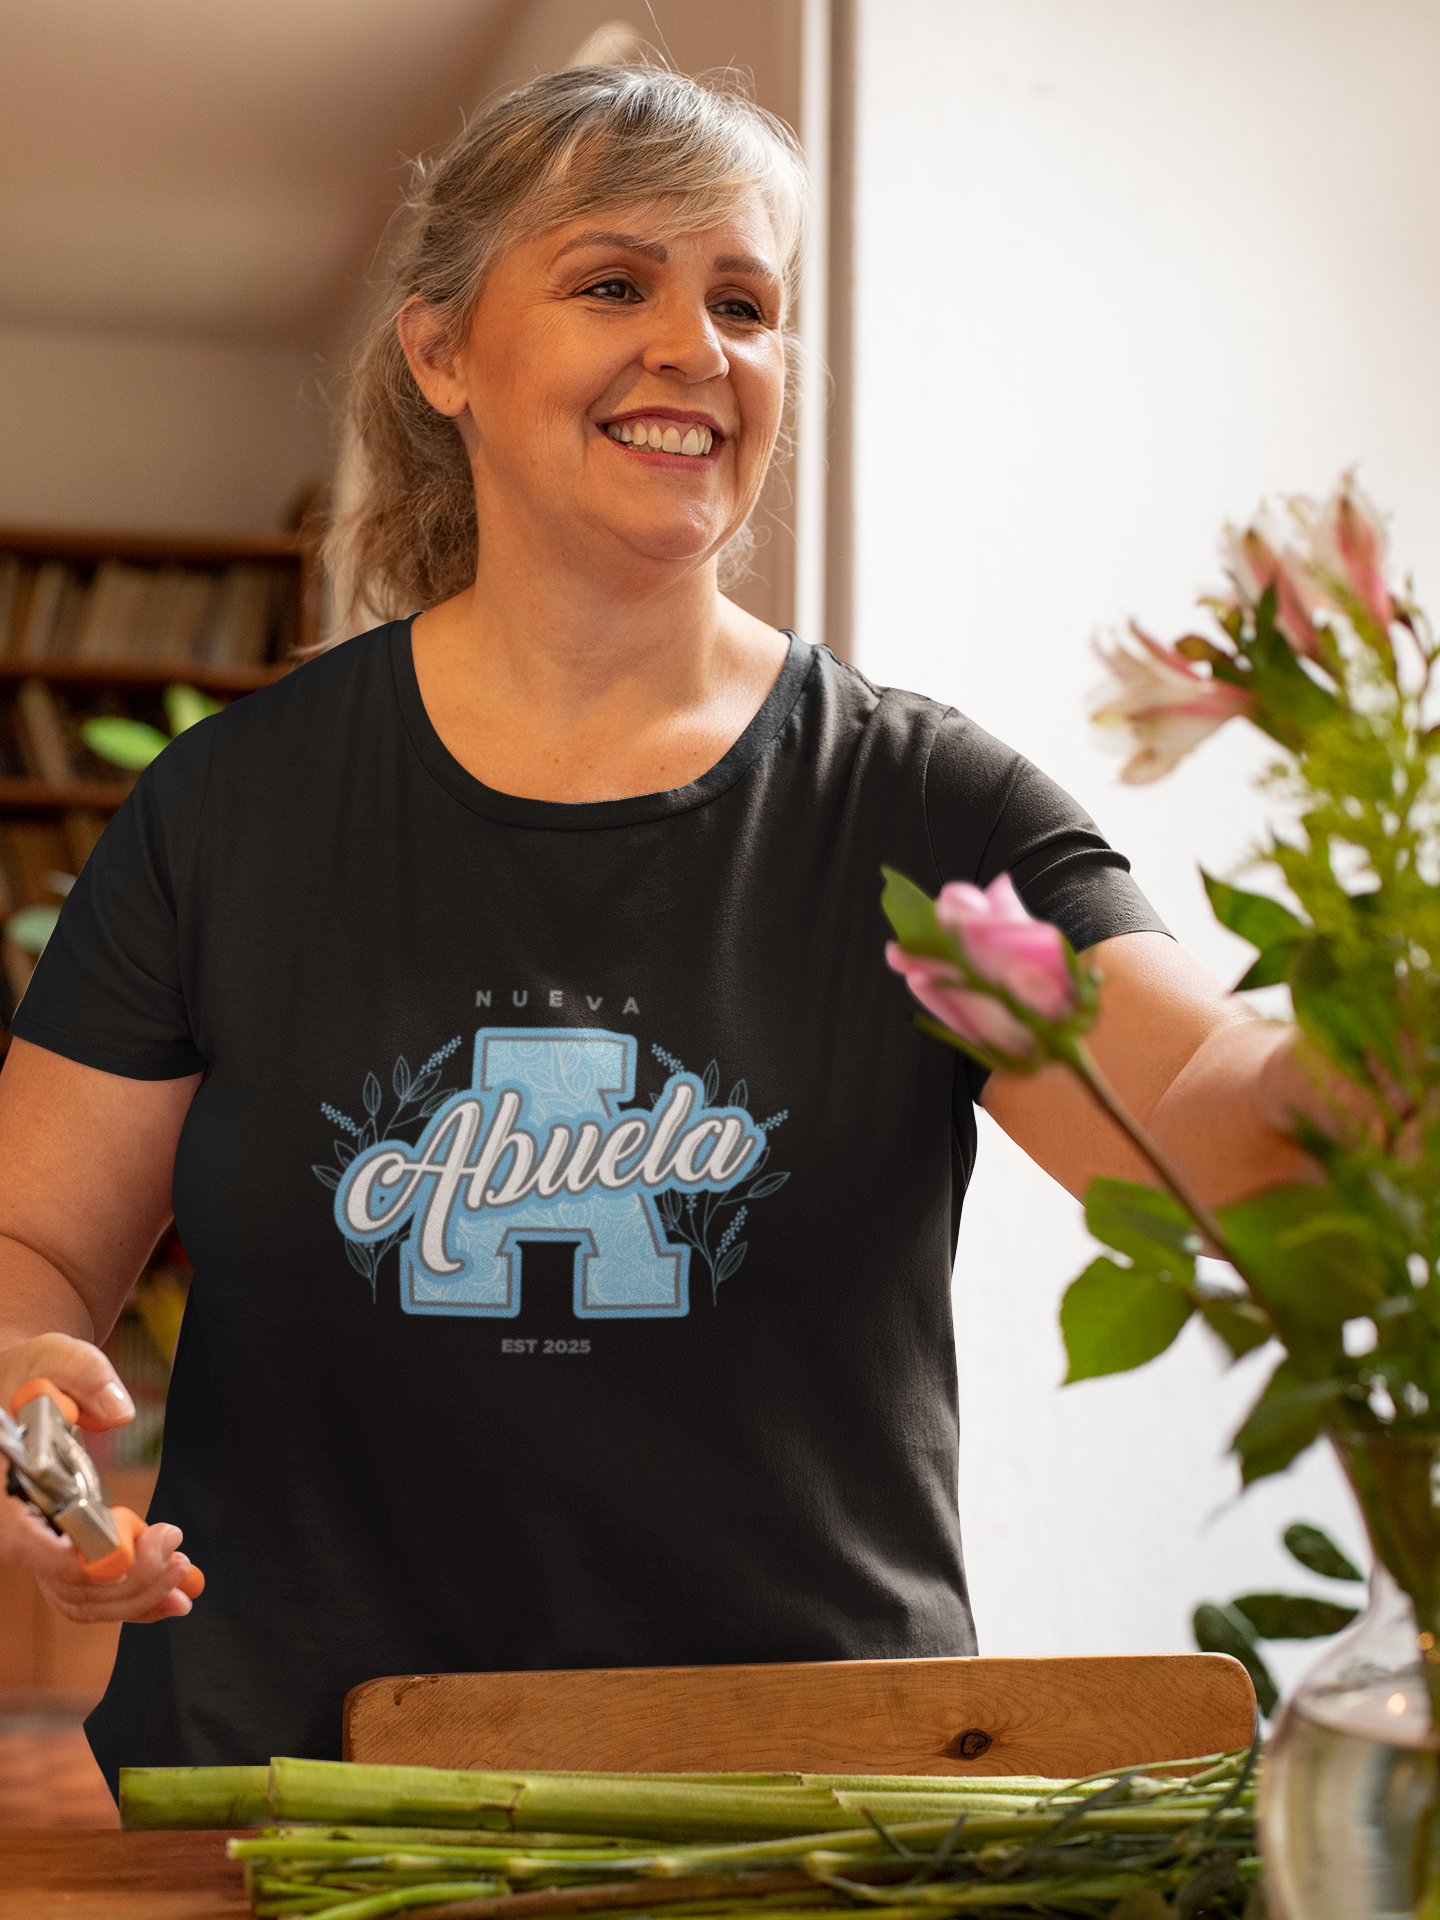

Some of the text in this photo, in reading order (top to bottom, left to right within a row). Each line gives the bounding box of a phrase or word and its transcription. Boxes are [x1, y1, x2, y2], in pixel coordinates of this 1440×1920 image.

[475, 989, 641, 1016] NUEVA
[341, 1079, 758, 1274] Abuela
[501, 1339, 592, 1354] EST 2025
